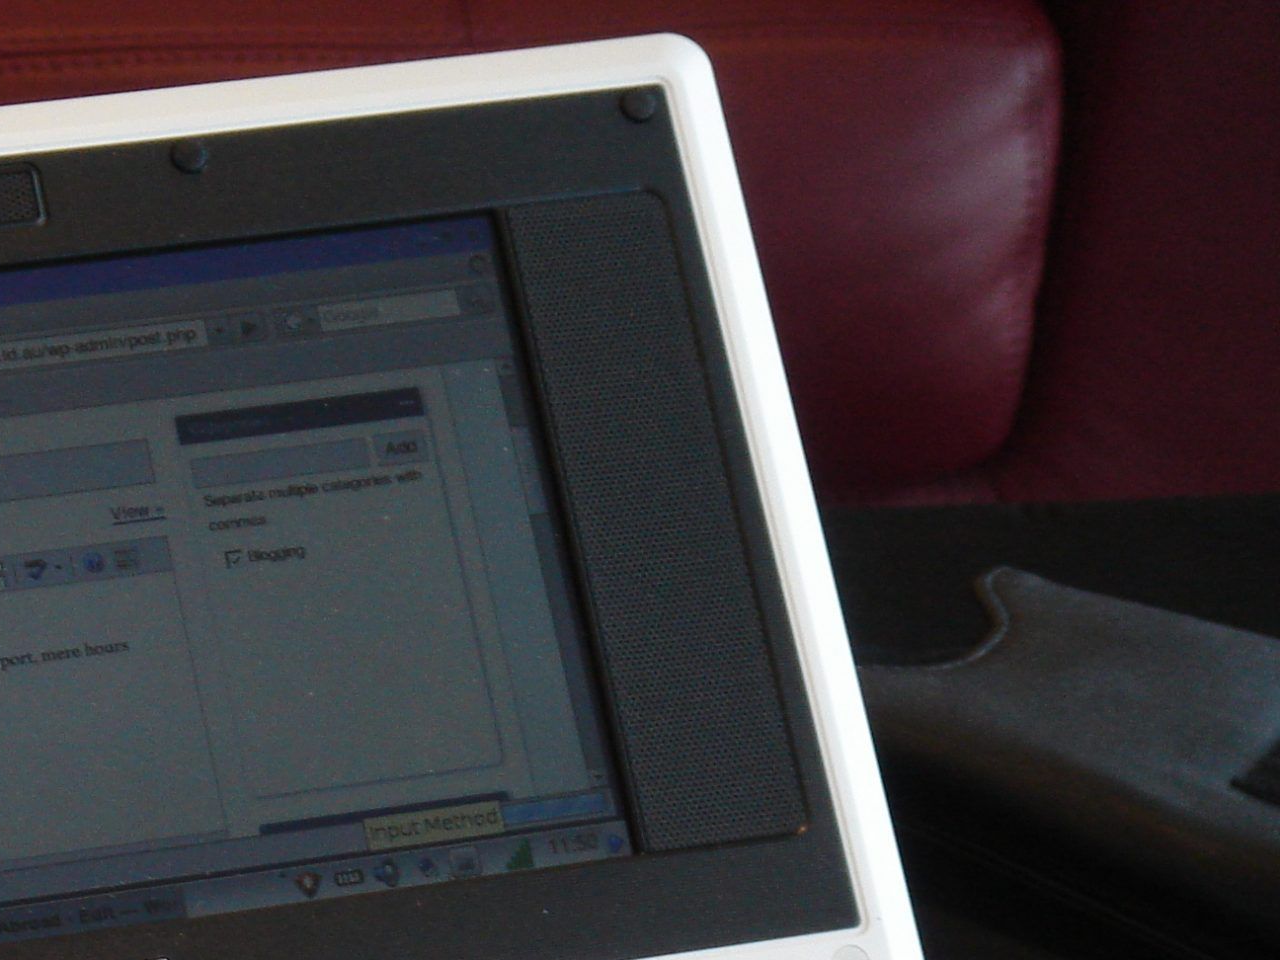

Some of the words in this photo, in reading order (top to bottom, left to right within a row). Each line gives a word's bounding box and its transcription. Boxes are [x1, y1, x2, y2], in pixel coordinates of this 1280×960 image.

[203, 488, 267, 509] Separate
[269, 481, 320, 500] multiple
[322, 473, 393, 493] categories
[247, 544, 308, 565] Blogging
[41, 645, 82, 663] mere
[84, 640, 130, 659] hours
[369, 820, 421, 845] Input
[423, 805, 501, 836] Method
